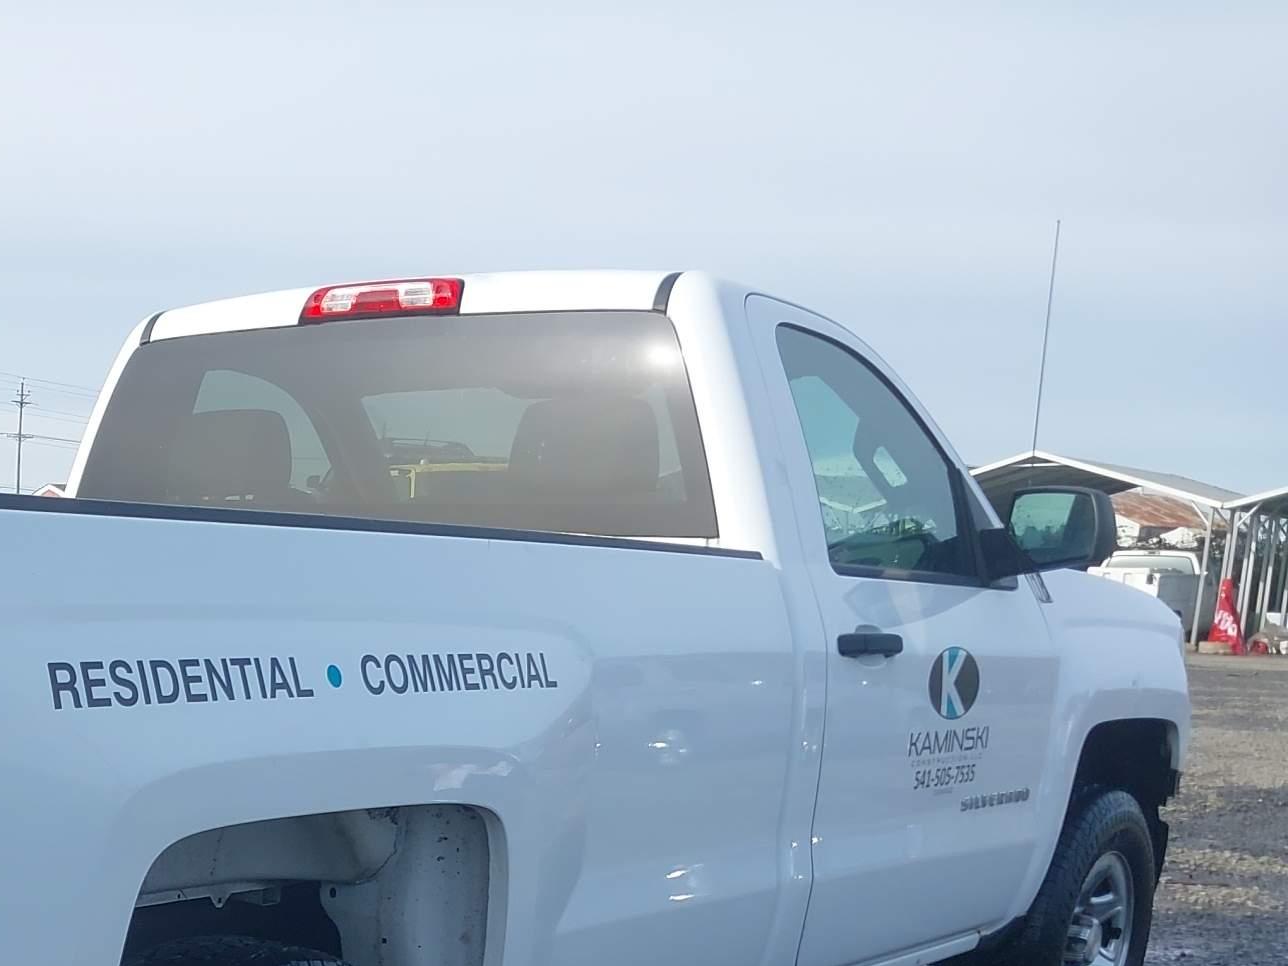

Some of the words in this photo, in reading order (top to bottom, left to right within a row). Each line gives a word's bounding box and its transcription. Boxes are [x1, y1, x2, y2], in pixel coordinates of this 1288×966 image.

[47, 656, 314, 710] RESIDENTIAL
[359, 652, 557, 697] COMMERCIAL
[908, 726, 989, 757] KAMINSKI
[914, 764, 976, 790] 541-505-7535
